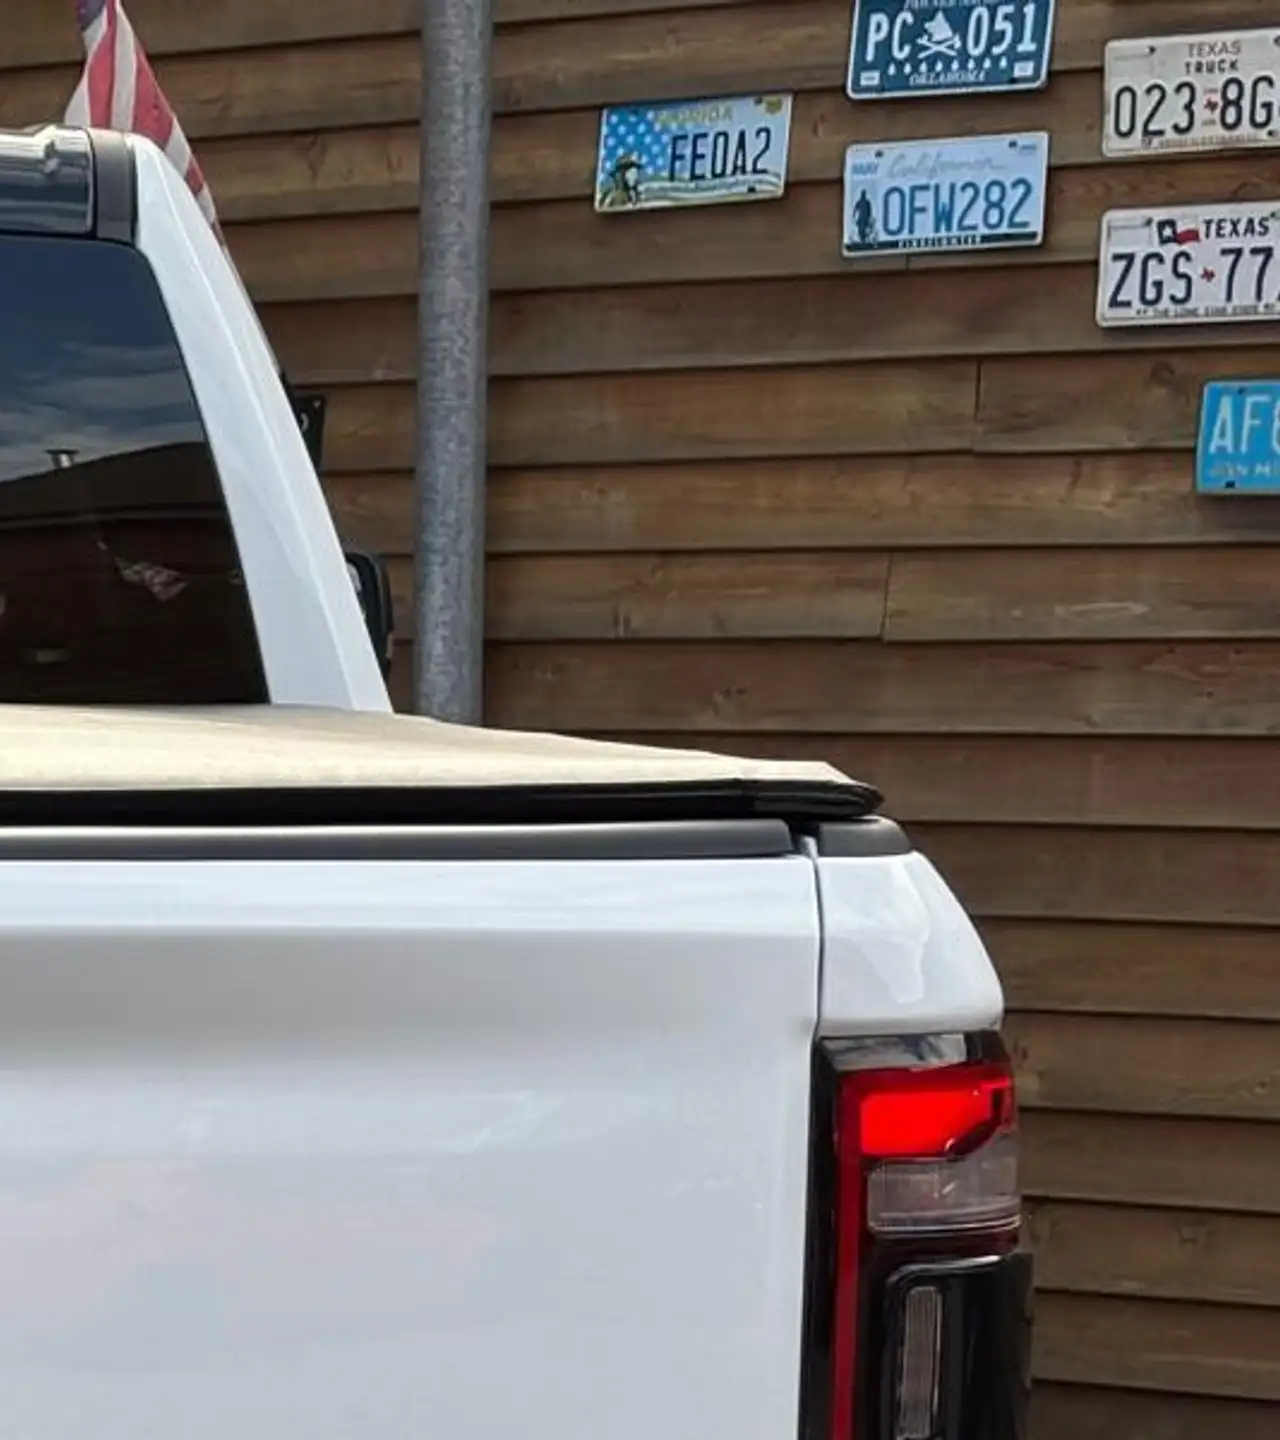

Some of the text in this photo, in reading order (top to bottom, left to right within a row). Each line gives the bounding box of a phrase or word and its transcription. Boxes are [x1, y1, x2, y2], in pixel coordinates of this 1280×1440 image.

[865, 3, 1038, 63] PC 051
[1188, 40, 1242, 58] TEXAS
[1185, 58, 1240, 75] TRUCK
[1113, 75, 1280, 139] 023 8G
[1202, 216, 1270, 239] TEXAS
[1108, 245, 1280, 308] ZGS 77
[1208, 395, 1280, 456] AF
